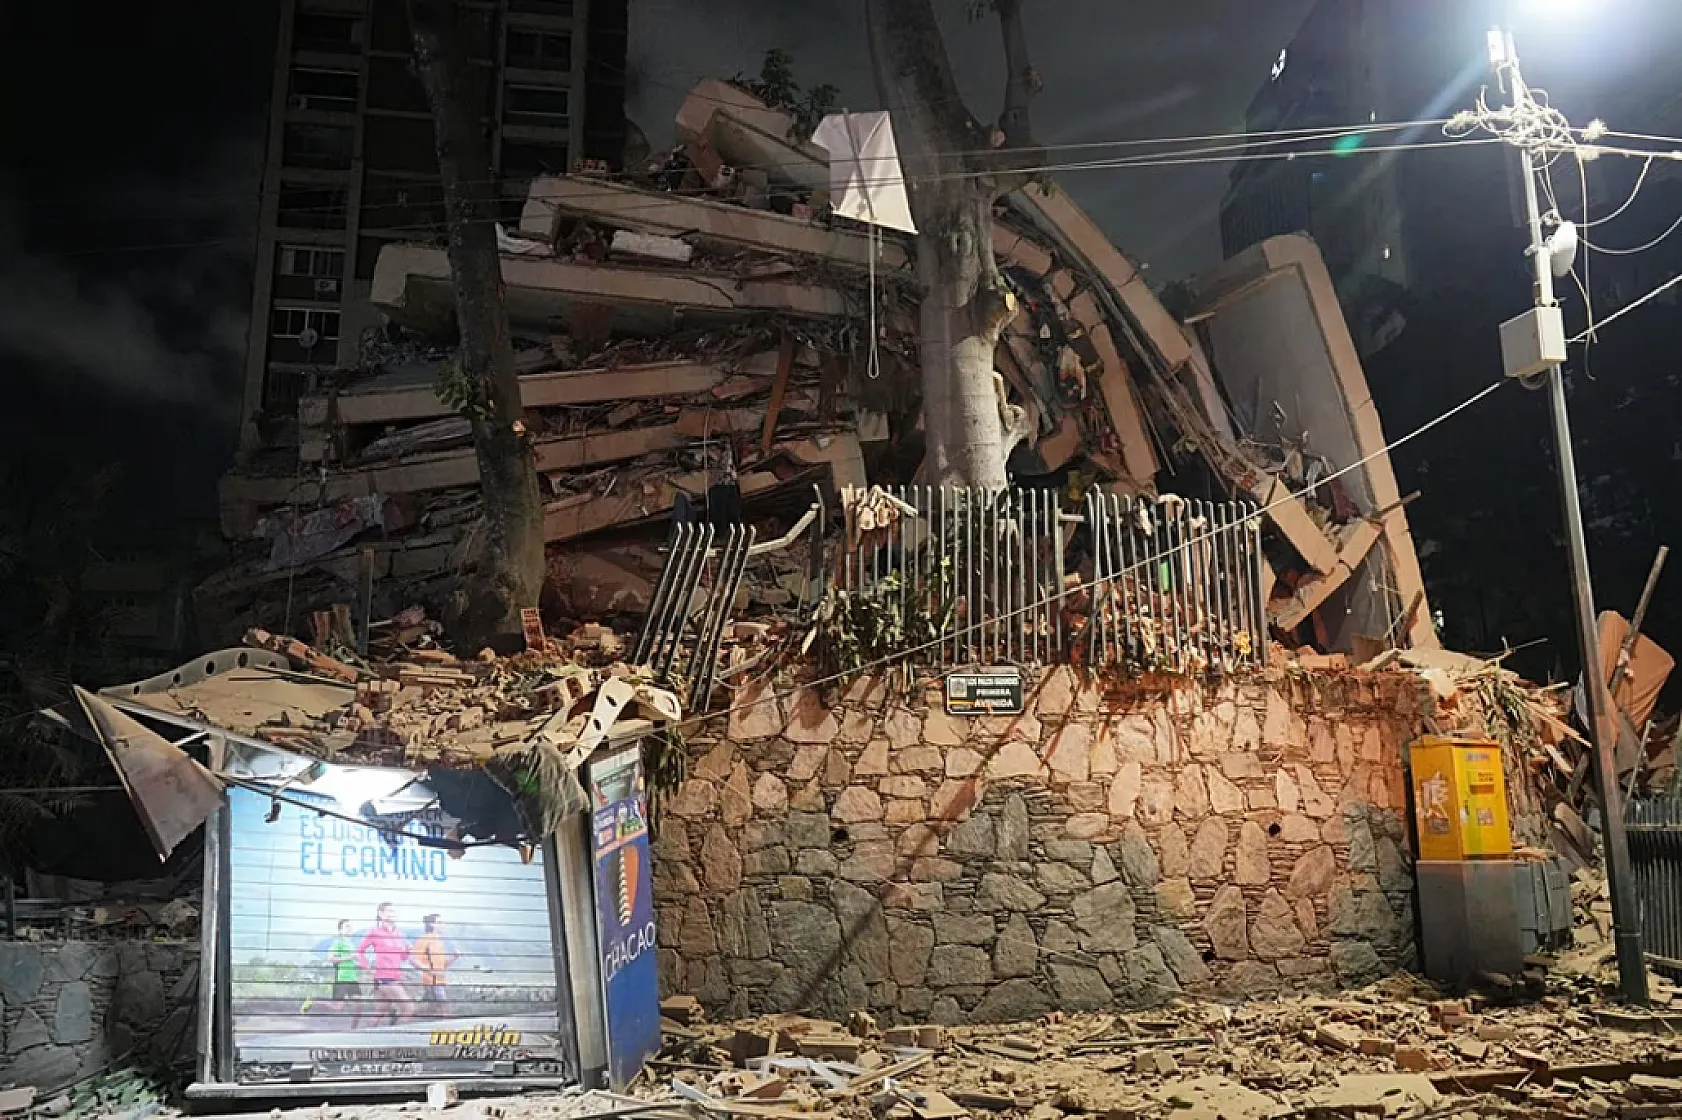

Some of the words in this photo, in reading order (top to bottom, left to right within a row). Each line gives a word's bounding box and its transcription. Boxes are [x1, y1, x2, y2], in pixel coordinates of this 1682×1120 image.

[300, 841, 333, 876] EL
[341, 845, 447, 882] CAMINO
[605, 921, 656, 982] CHACAO
